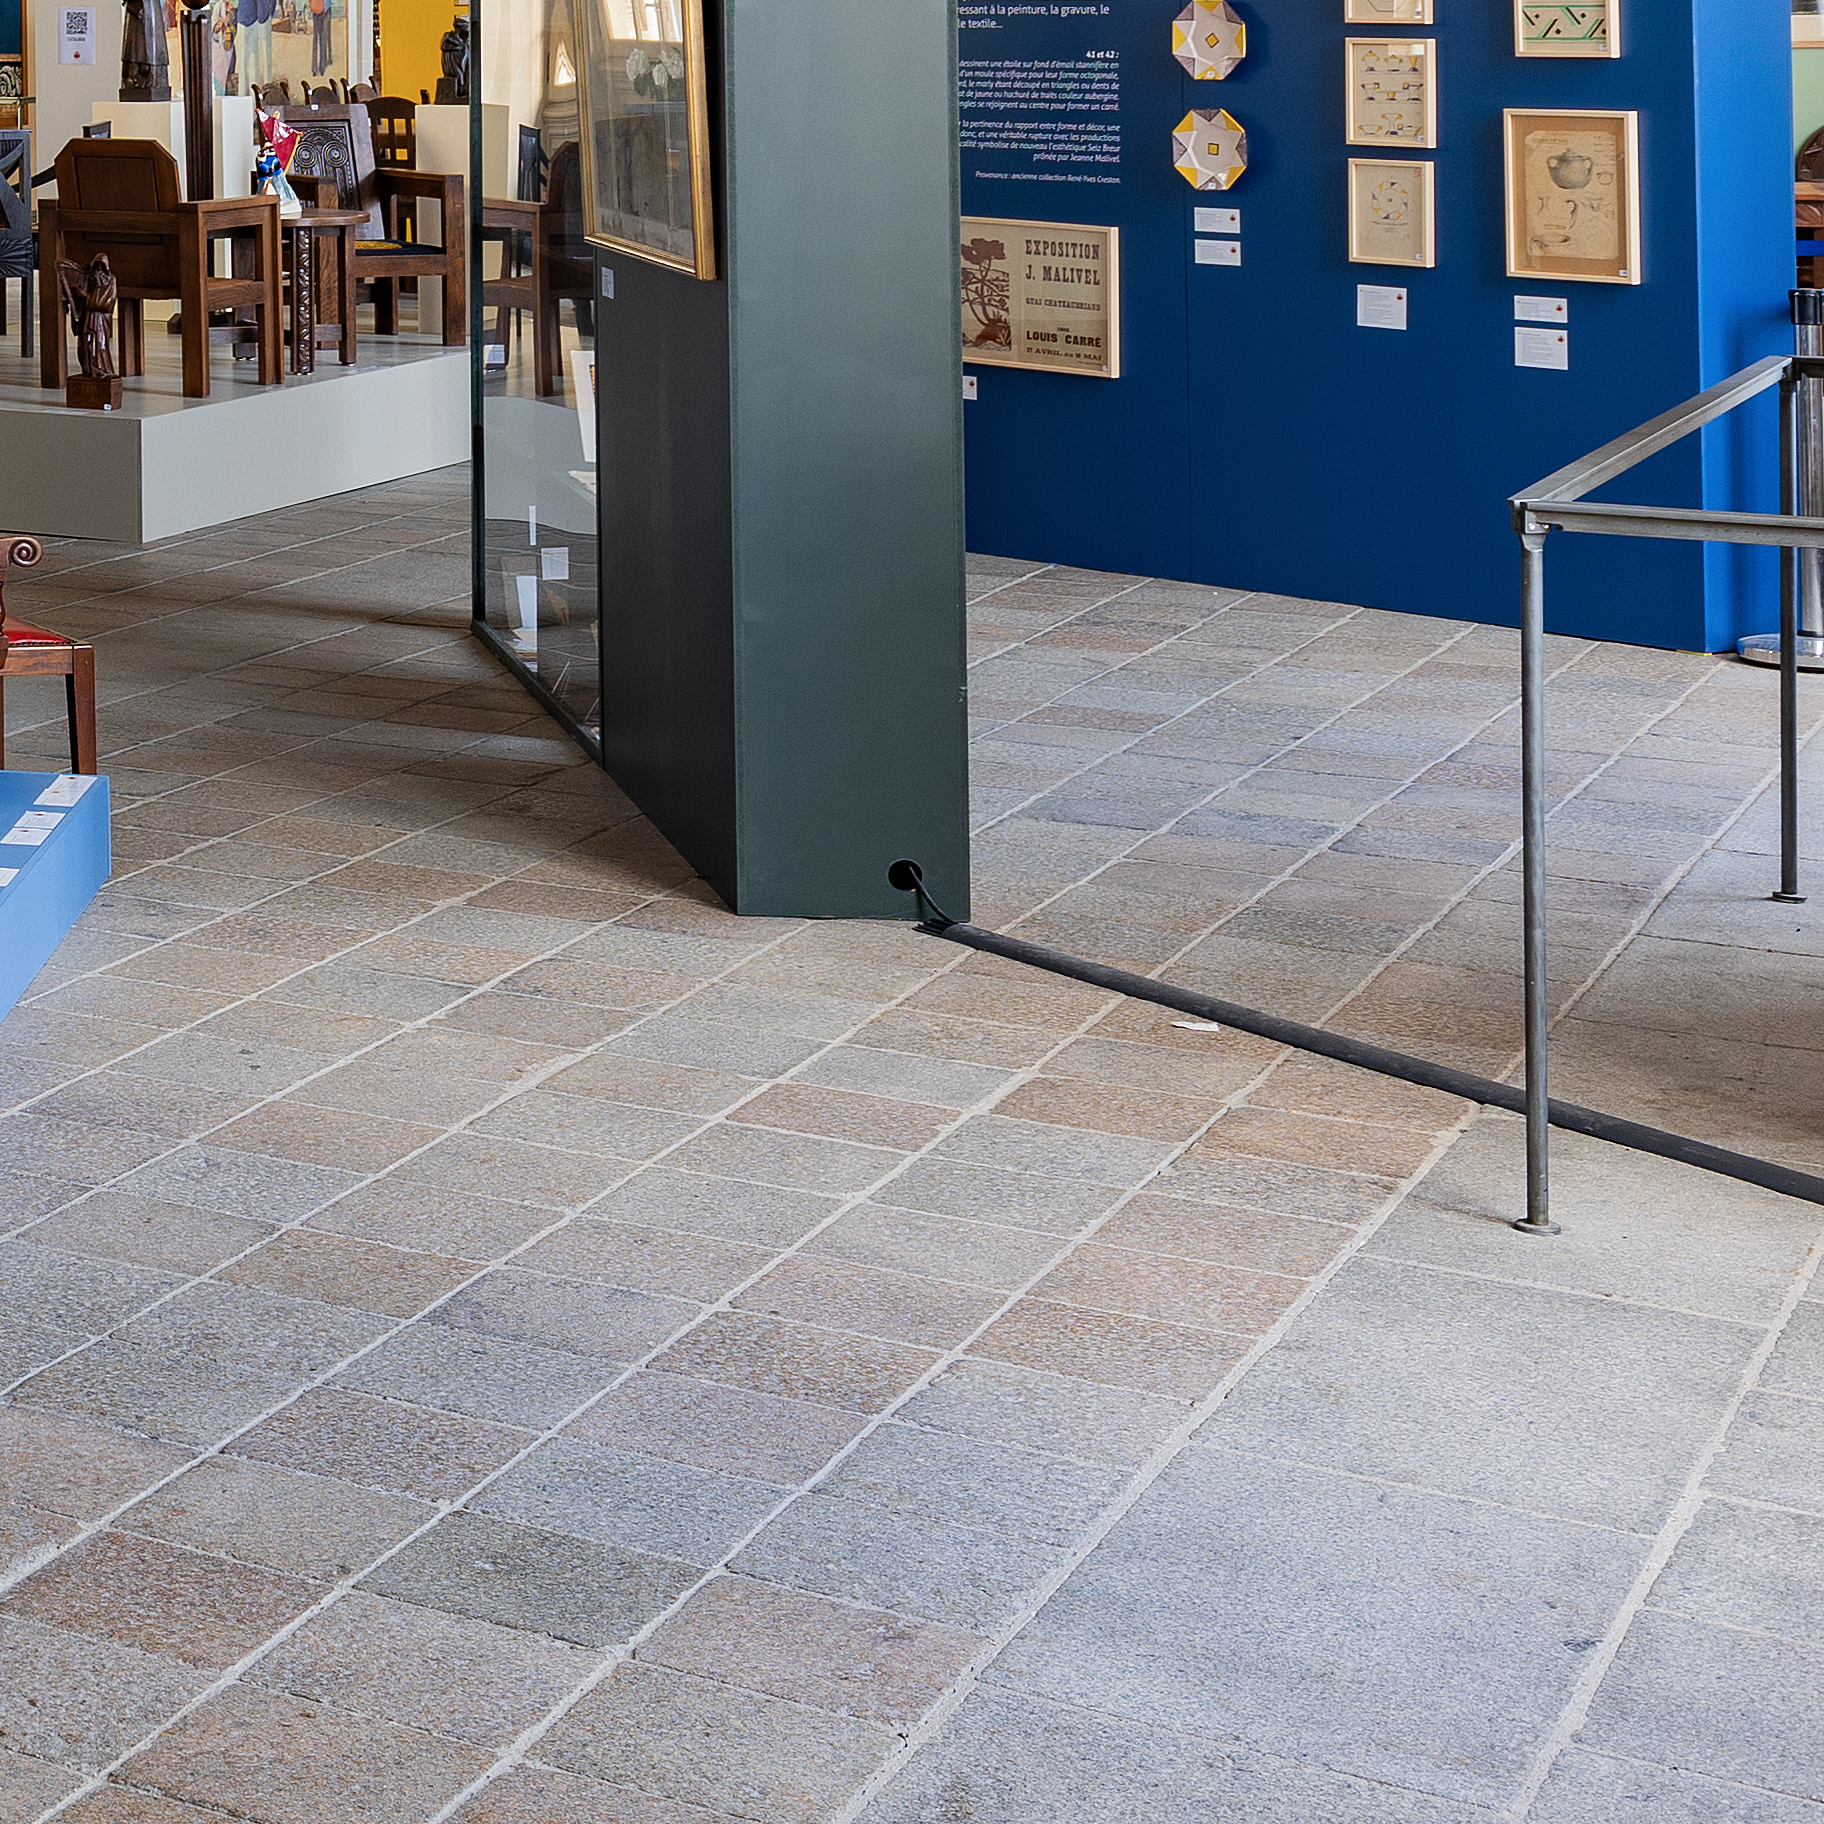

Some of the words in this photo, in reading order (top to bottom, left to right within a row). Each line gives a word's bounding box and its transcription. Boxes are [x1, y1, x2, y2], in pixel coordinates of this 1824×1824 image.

[989, 4, 995, 15] à
[996, 4, 1006, 15] la
[1007, 4, 1049, 17] peinture,
[1050, 3, 1059, 15] la
[1060, 6, 1099, 17] gravure,
[1100, 3, 1110, 15] le
[1025, 239, 1100, 260] EXPOSITION
[1025, 264, 1036, 280] J.
[1042, 265, 1100, 286] MALIVEL
[1026, 330, 1058, 343] LOUIS
